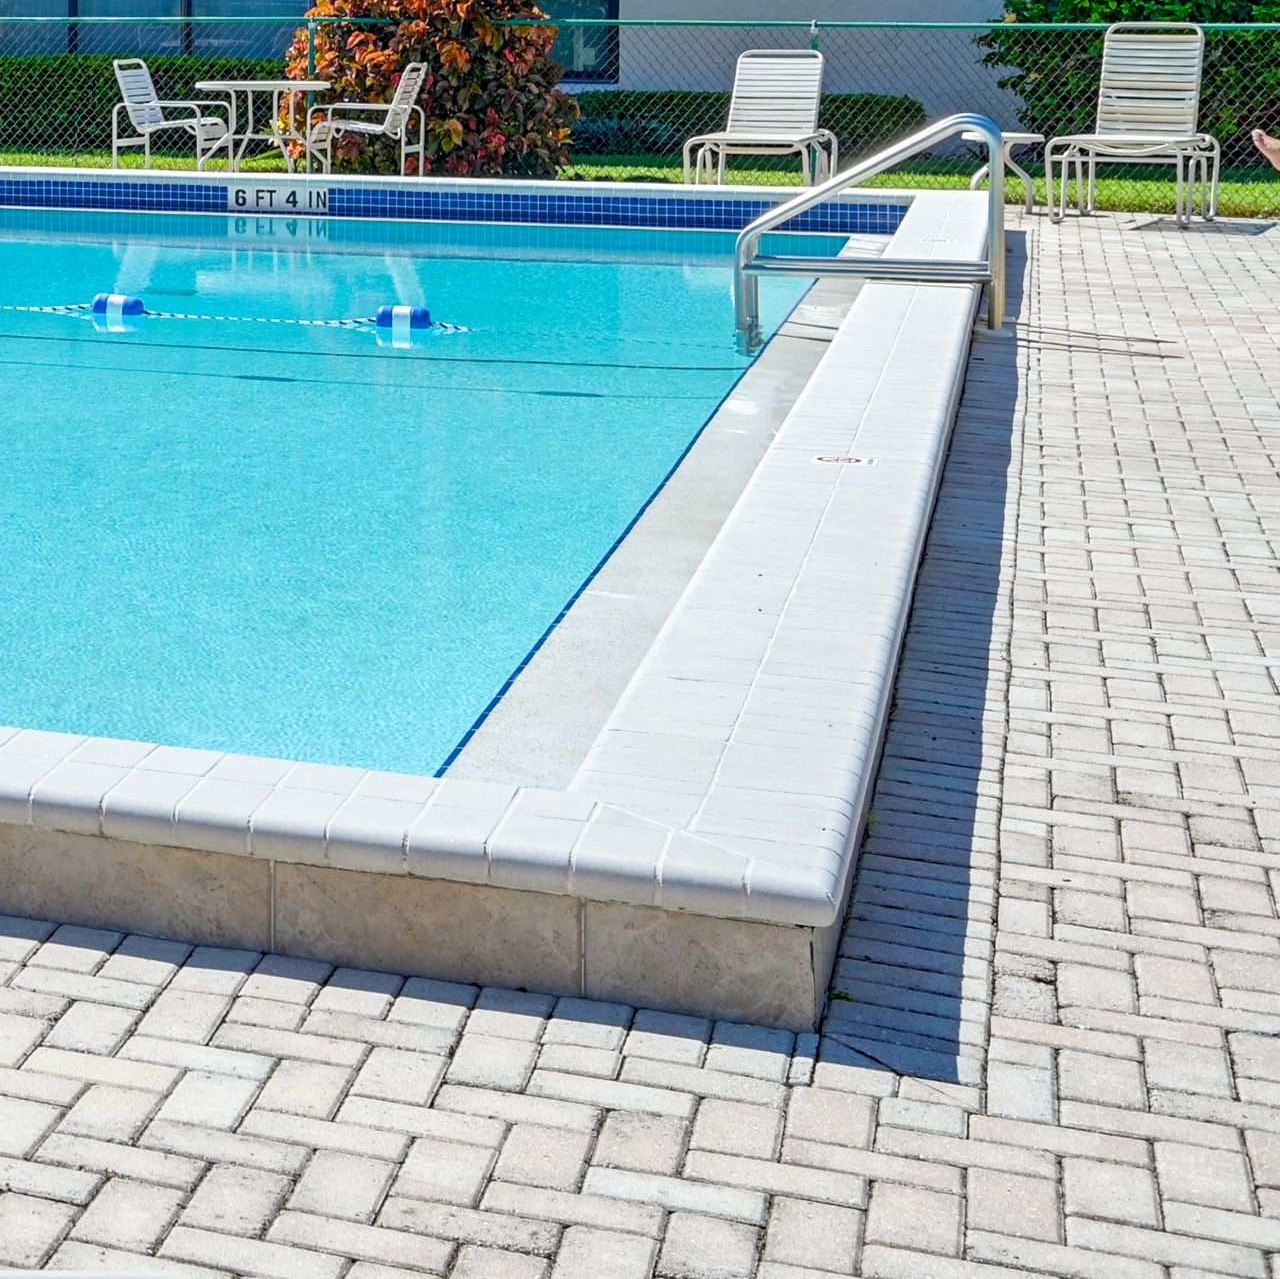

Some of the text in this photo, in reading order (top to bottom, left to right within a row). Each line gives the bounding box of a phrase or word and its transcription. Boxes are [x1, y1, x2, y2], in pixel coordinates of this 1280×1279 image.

[234, 189, 327, 209] 6 FT 4 IN
